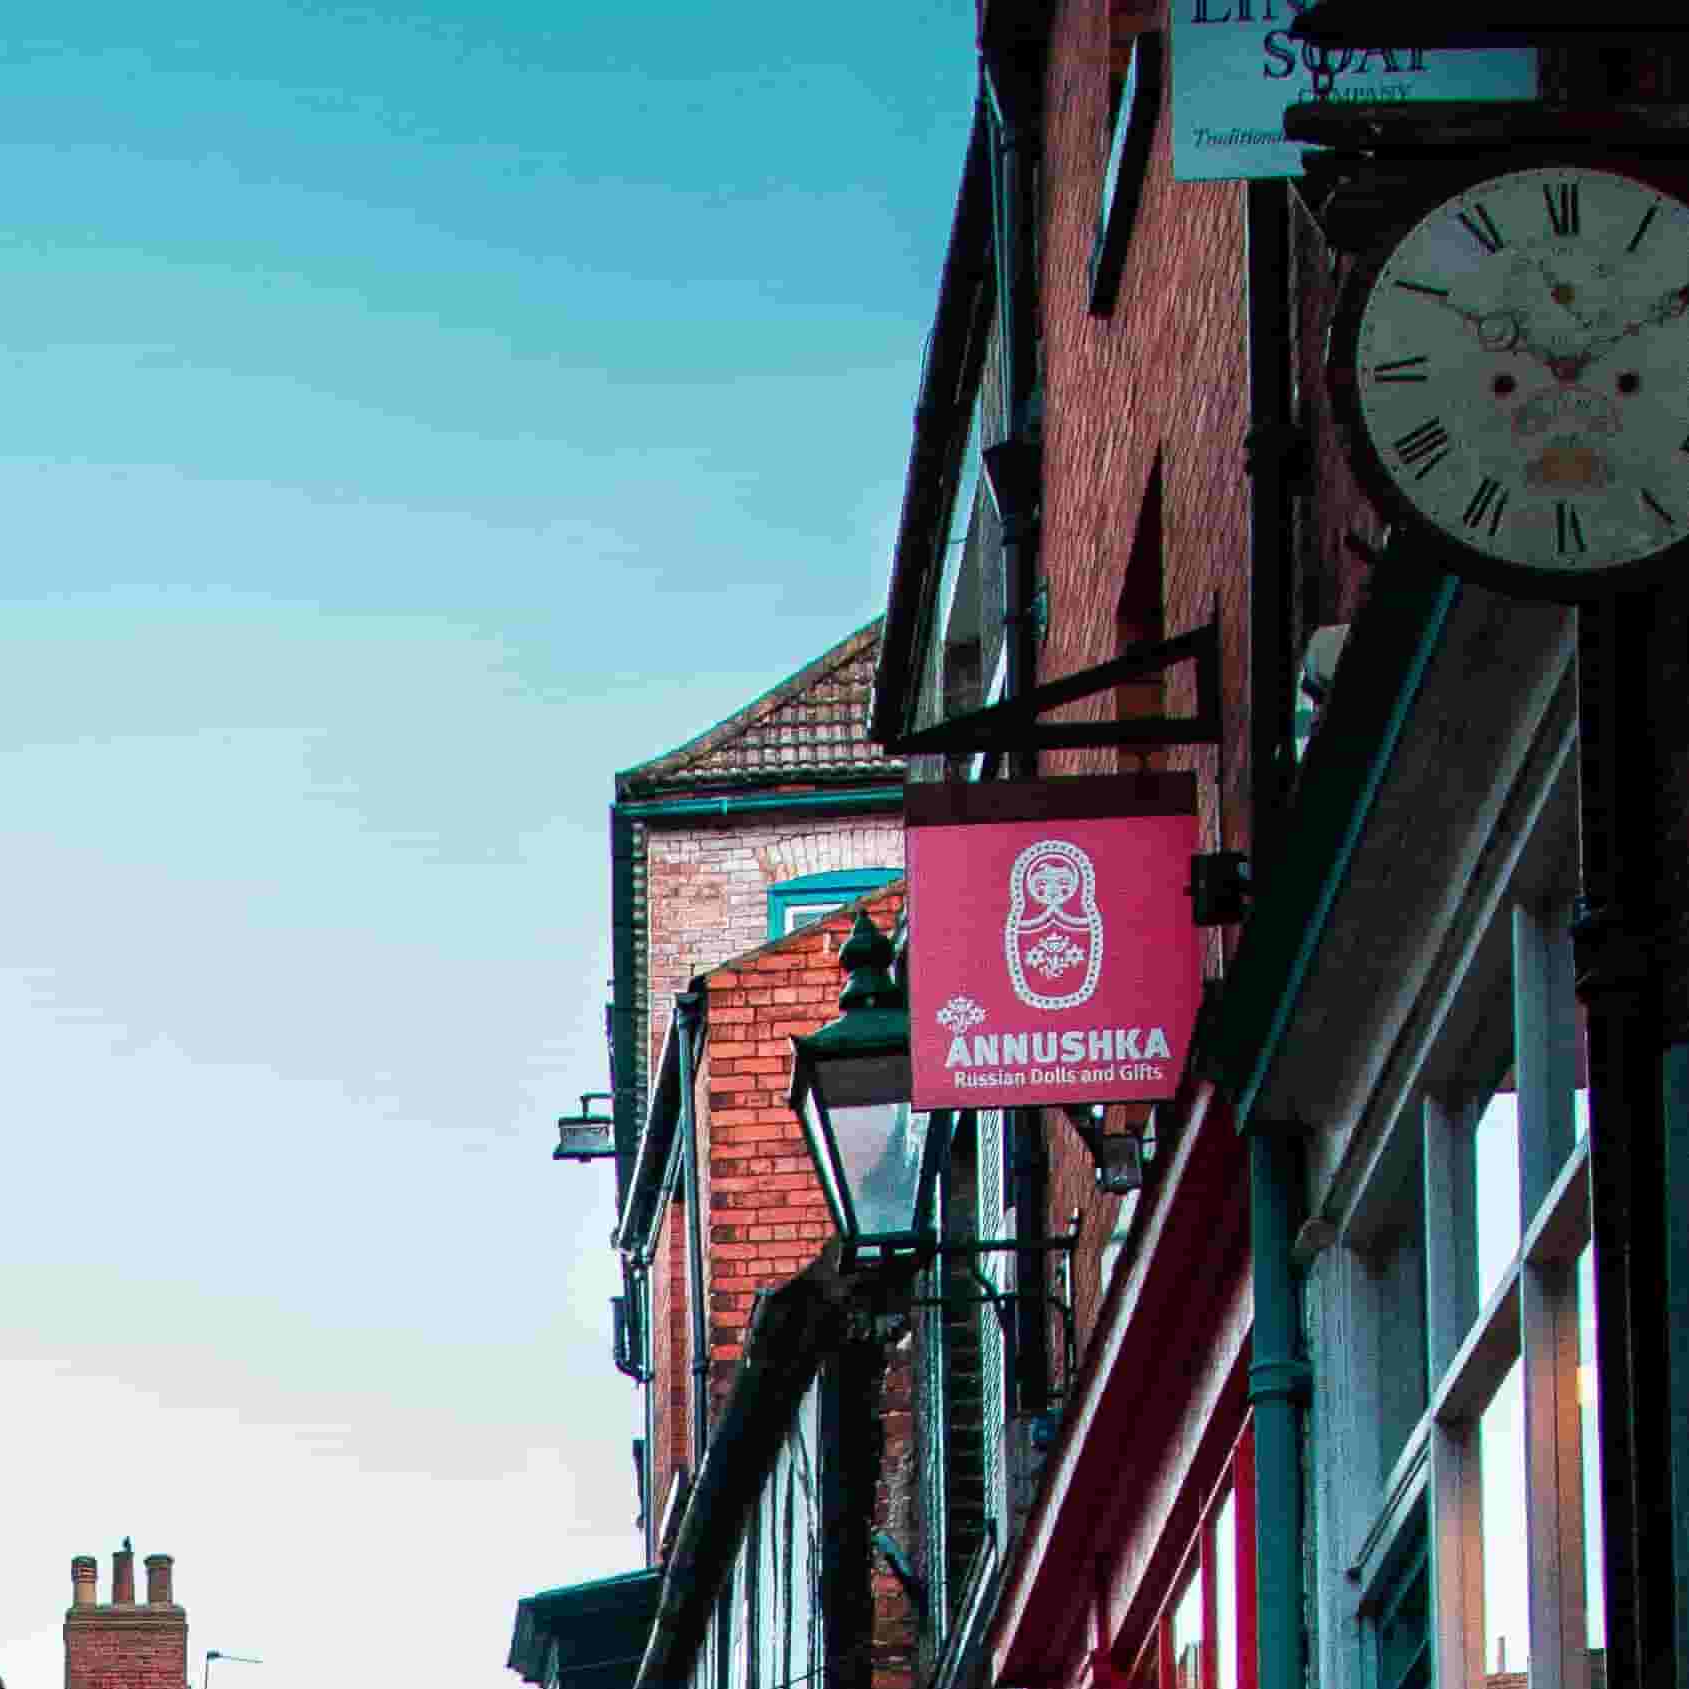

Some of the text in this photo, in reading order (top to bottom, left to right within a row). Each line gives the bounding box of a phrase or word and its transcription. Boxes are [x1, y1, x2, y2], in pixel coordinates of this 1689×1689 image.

[1298, 85, 1414, 104] CMPANY
[1193, 127, 1287, 147] Traditiona
[945, 1026, 1175, 1068] ANNUSHKA
[954, 1062, 1164, 1088] Russian Dolls and Gifts
